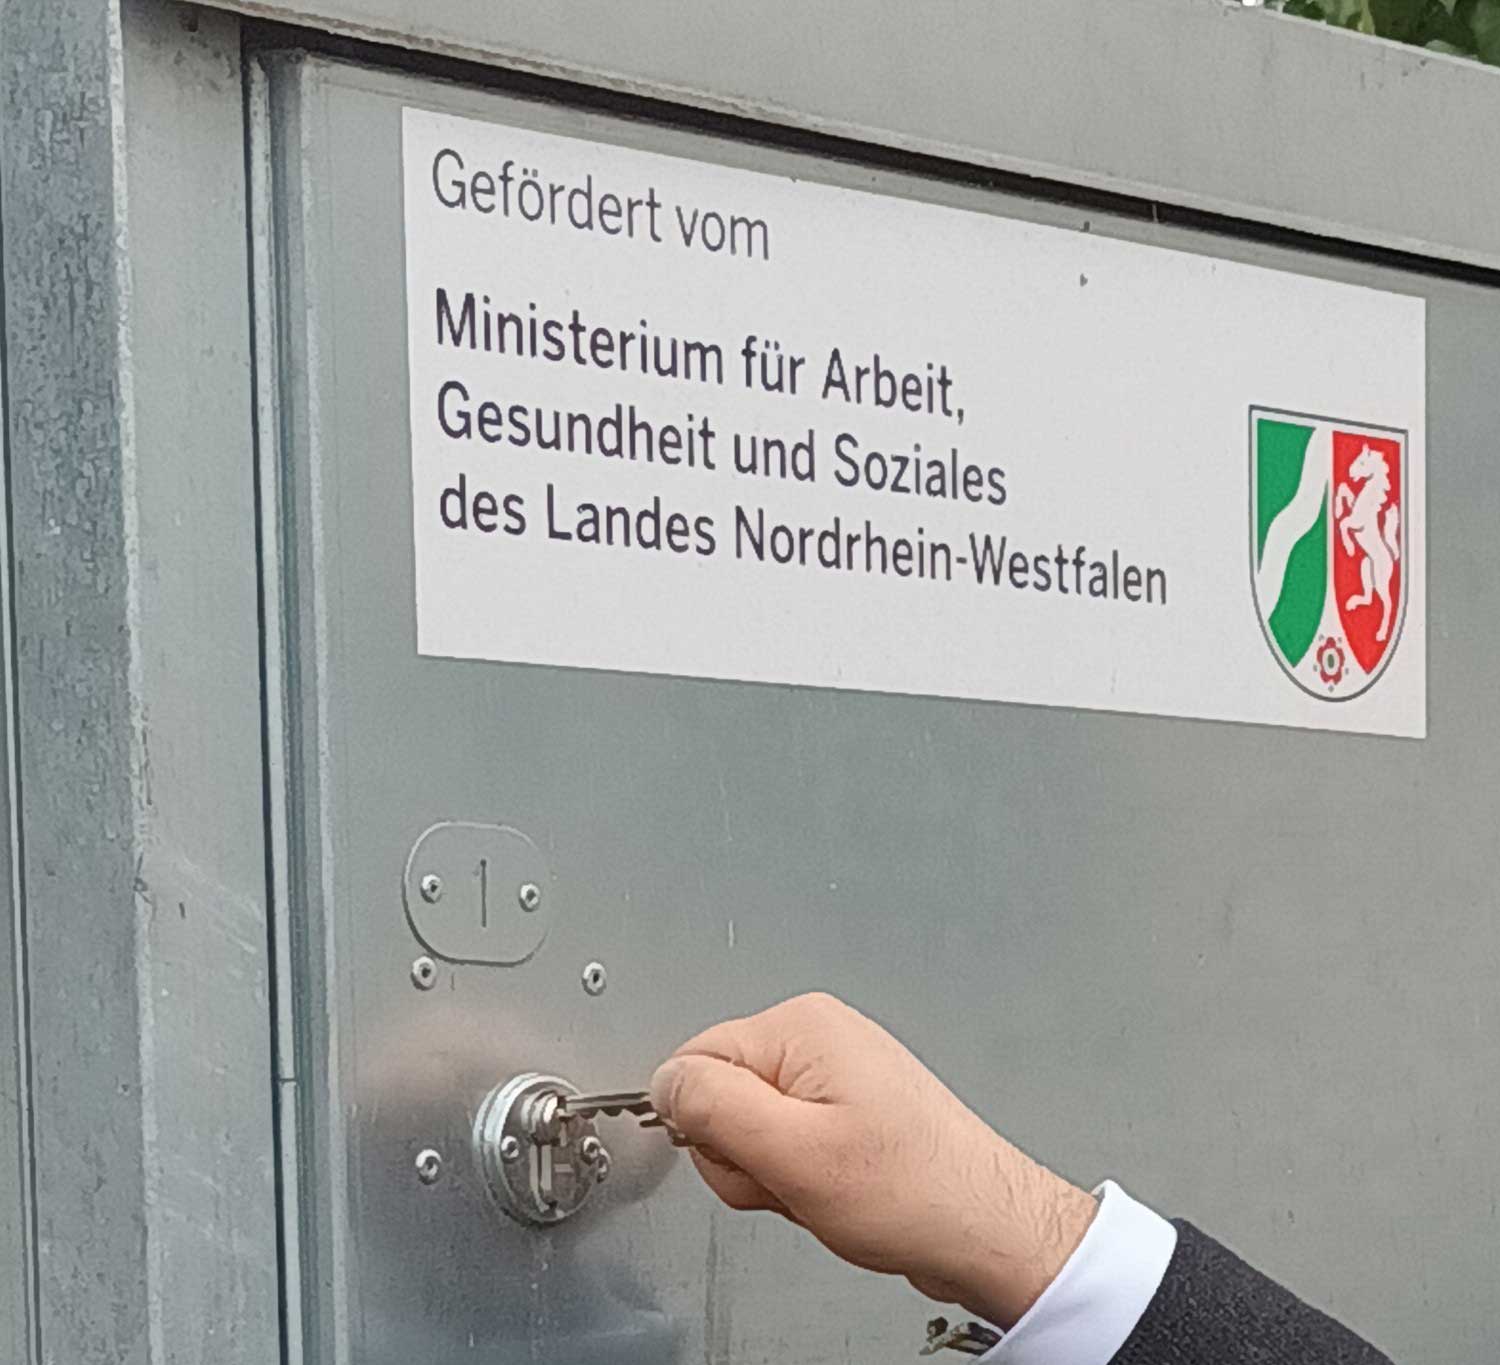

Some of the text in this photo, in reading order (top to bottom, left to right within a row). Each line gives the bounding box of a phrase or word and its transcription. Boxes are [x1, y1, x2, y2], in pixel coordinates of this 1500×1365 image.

[432, 148, 769, 260] Gefördert vom
[435, 287, 965, 424] Ministerium für Arbeit,
[437, 380, 1007, 506] Gesundheit und Soziales
[439, 472, 1167, 605] des Landes Nordrhein-Westfalen
